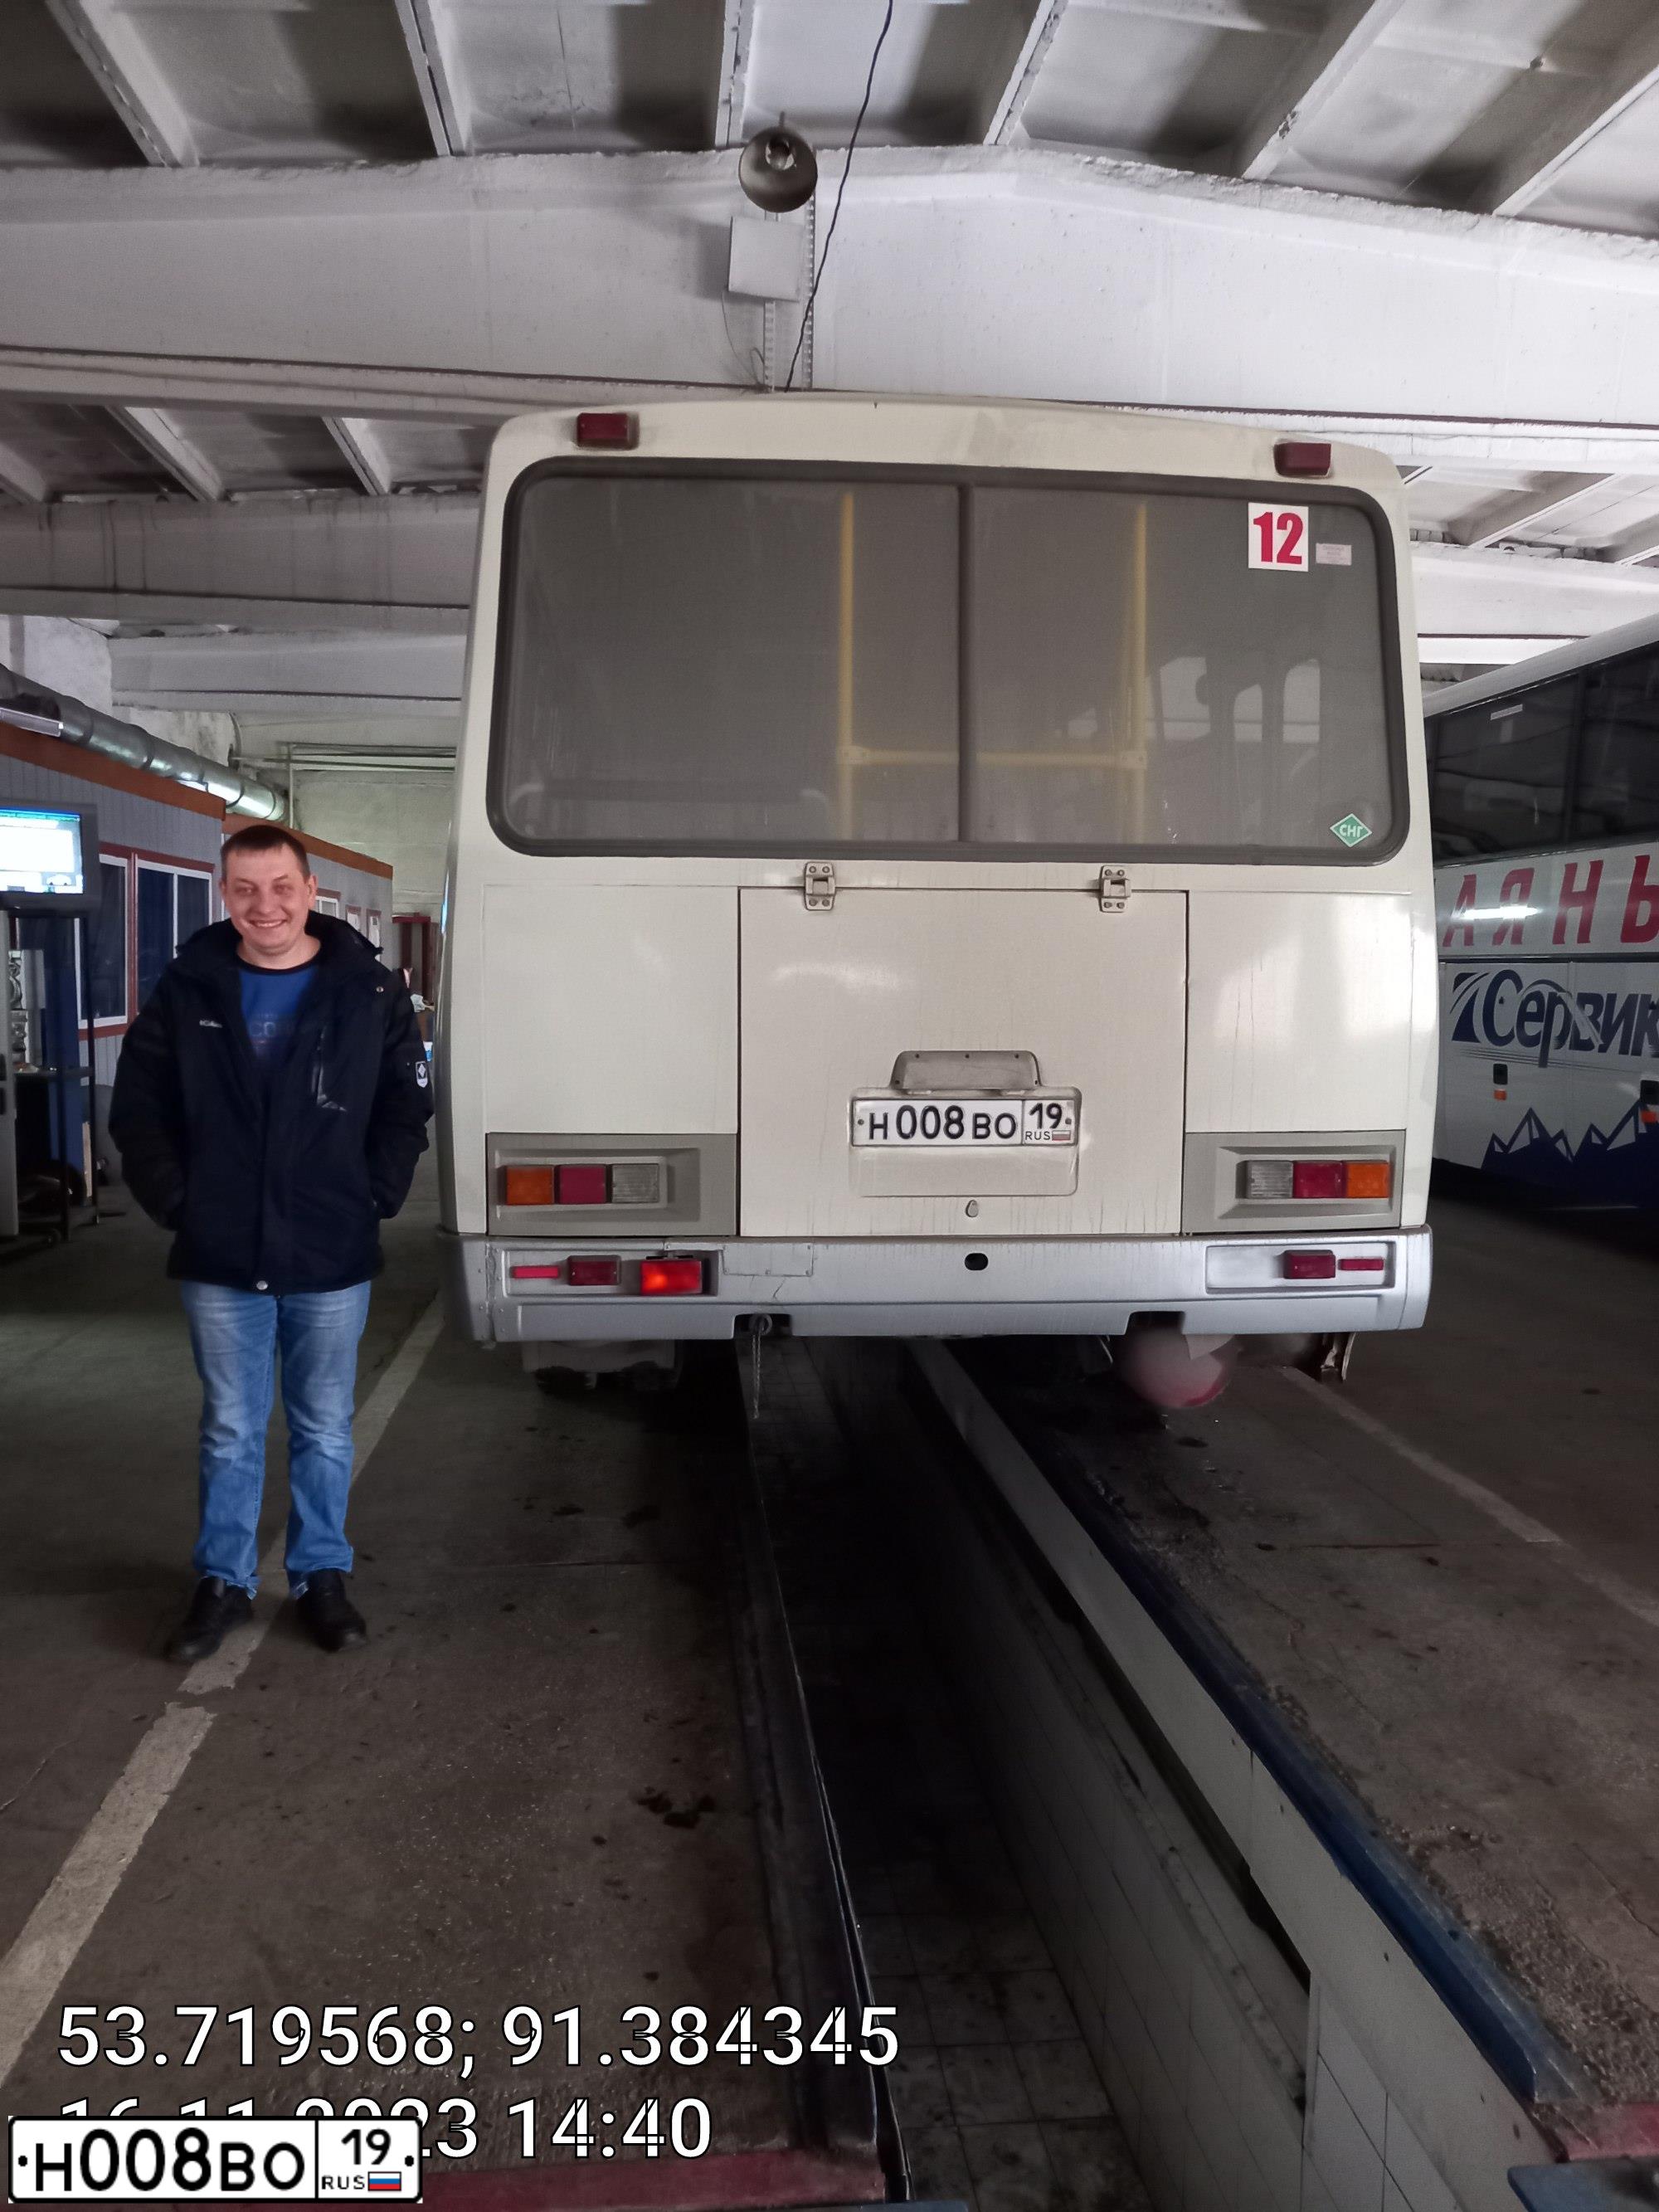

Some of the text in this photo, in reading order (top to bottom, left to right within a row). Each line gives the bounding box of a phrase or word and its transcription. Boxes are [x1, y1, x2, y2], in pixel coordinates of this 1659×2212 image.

[1253, 512, 1303, 564] 12
[1029, 1103, 1063, 1129] 19
[1025, 1131, 1051, 1141] RUS
